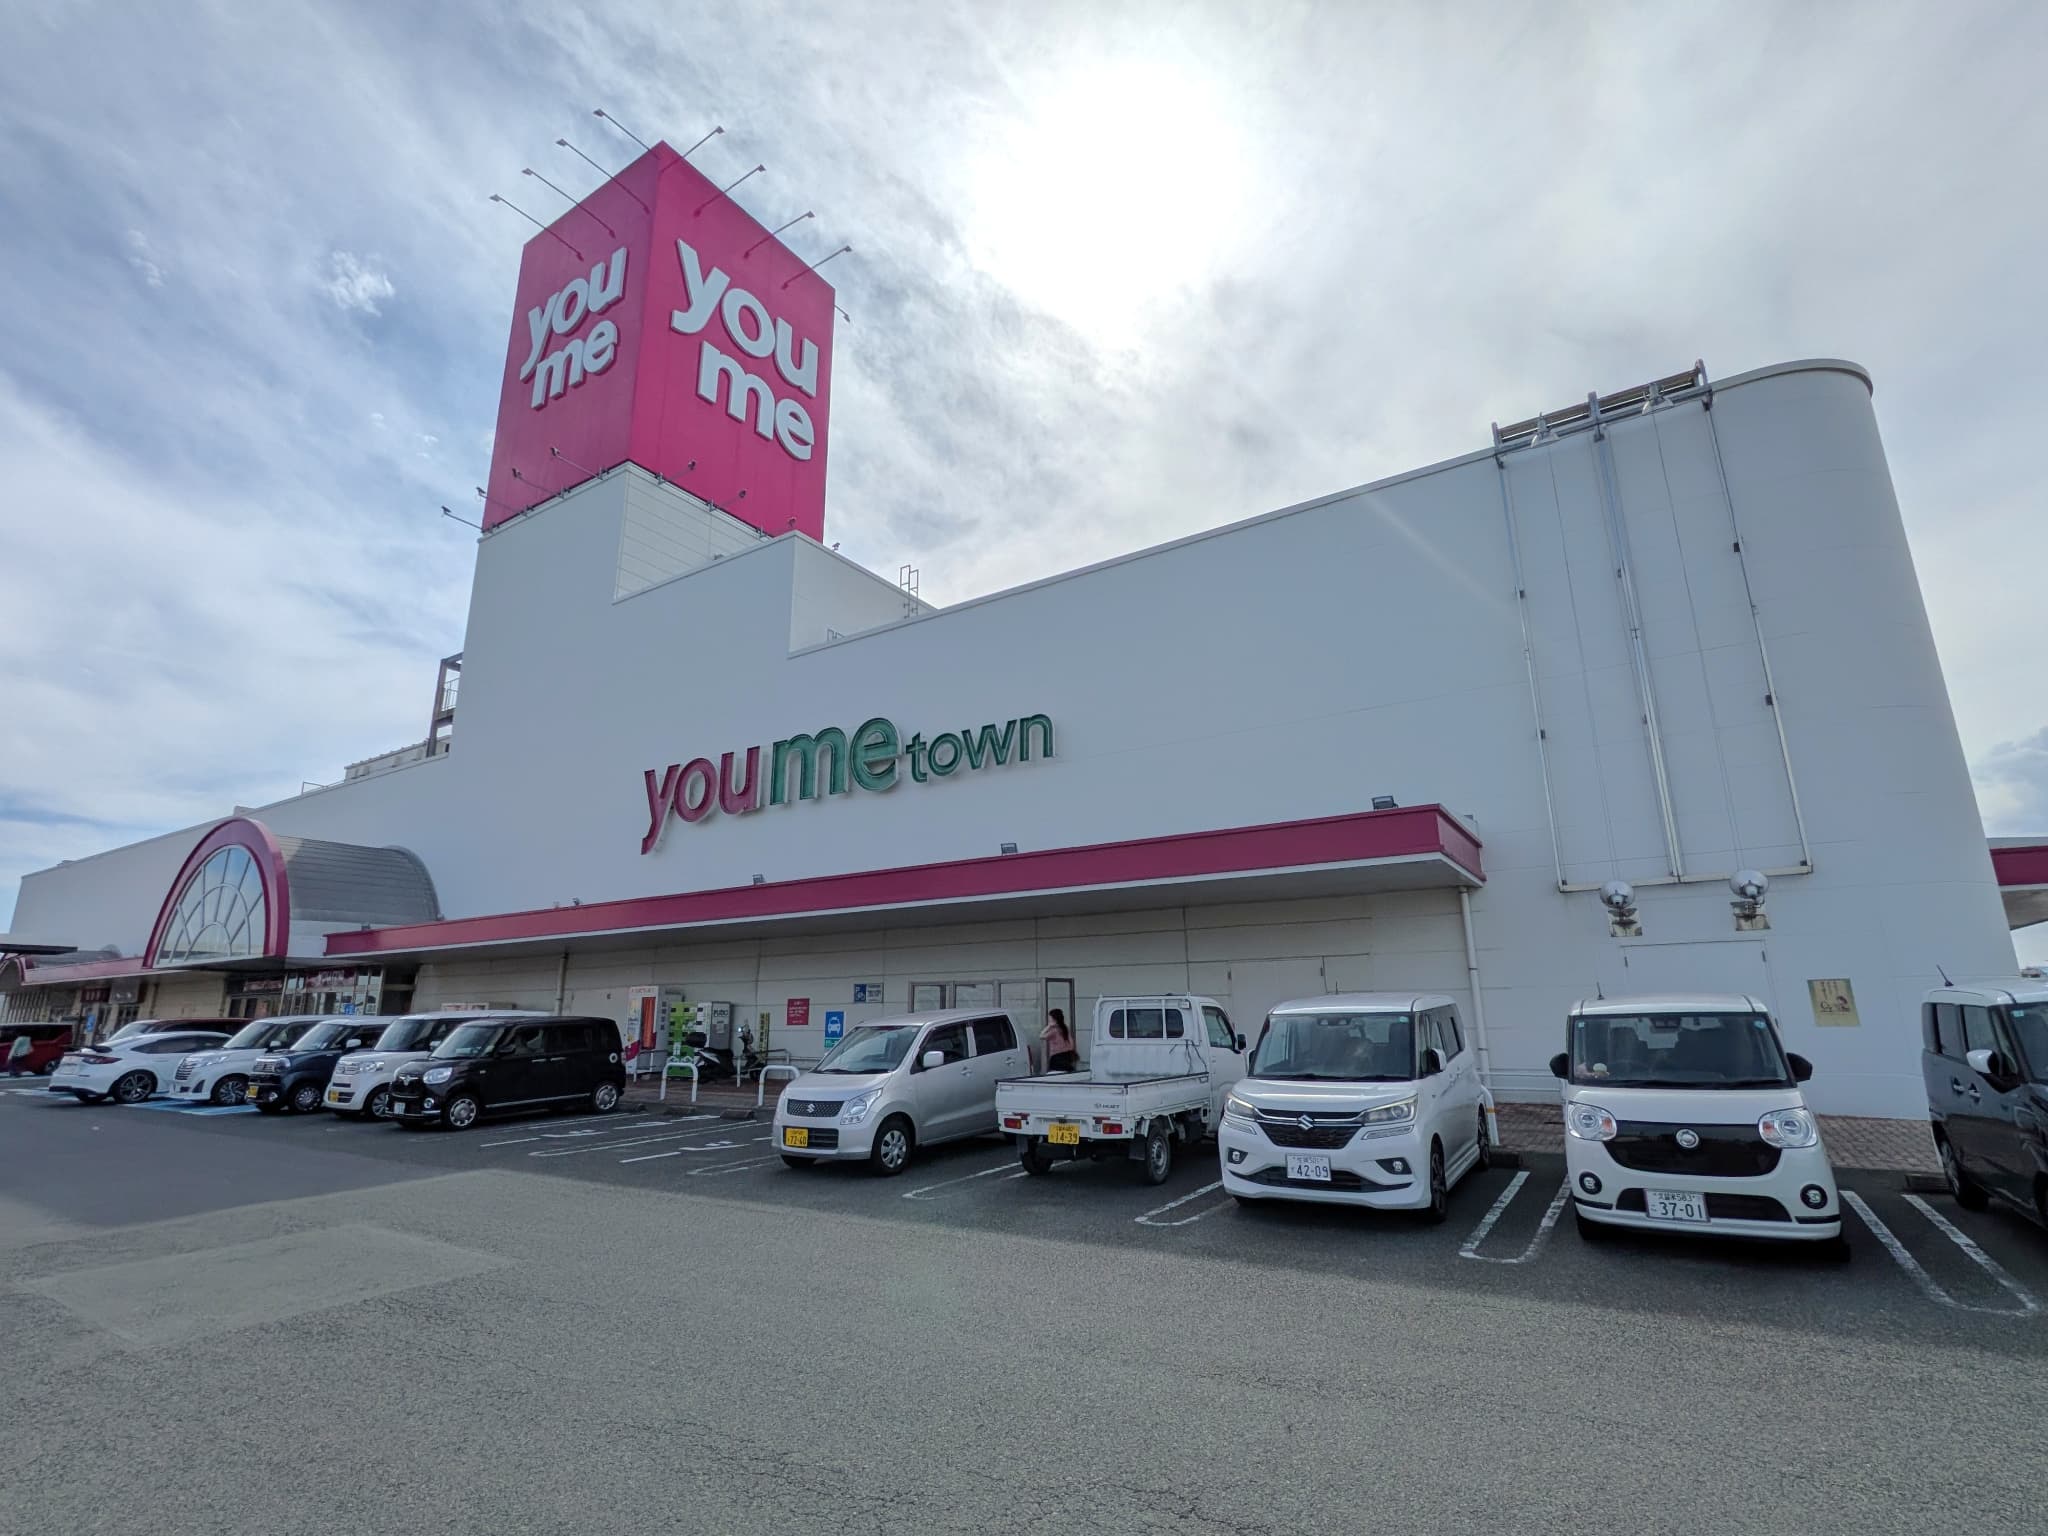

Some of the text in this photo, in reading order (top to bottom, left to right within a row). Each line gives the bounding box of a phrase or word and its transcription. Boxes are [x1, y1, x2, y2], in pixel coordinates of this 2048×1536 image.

[520, 246, 628, 382] you
[670, 238, 819, 398] you
[531, 320, 619, 410] me
[696, 340, 815, 461] me
[905, 713, 1056, 784] town
[1296, 1164, 1329, 1178] 42-09
[1658, 1201, 1703, 1219] 37-01
